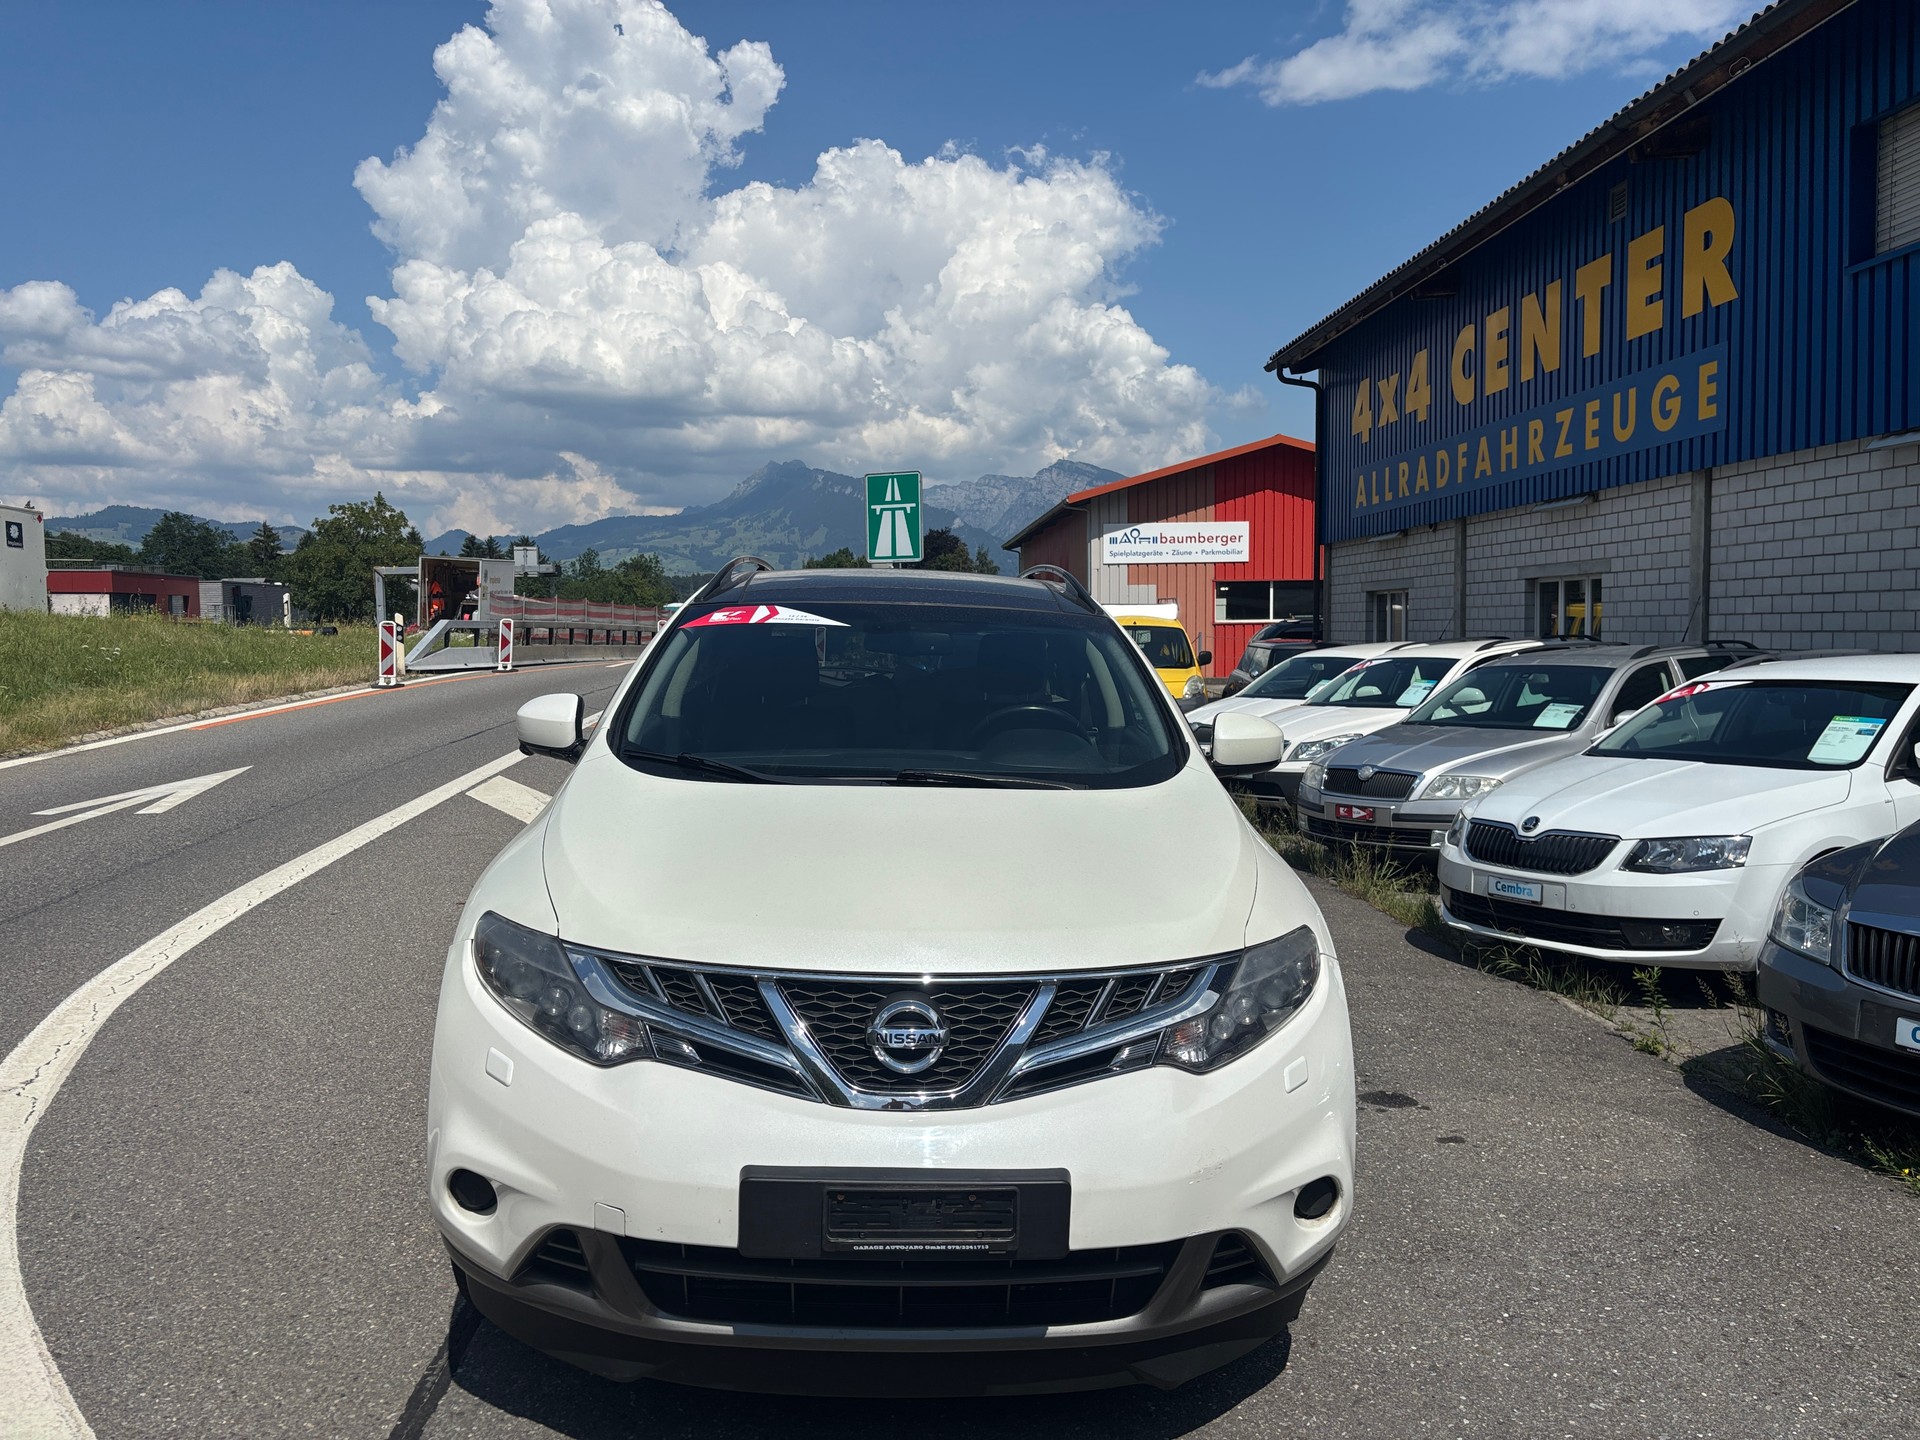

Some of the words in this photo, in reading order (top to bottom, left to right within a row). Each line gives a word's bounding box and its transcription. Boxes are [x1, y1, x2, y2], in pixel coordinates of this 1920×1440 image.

[1352, 348, 1431, 444] 4x4
[1450, 196, 1739, 406] CENTER
[1355, 360, 1718, 509] ALLRADFAHRZEUGE
[1159, 532, 1244, 546] baumberger
[1200, 548, 1244, 556] Parkmobiliar
[1495, 880, 1534, 897] Cembra
[875, 1033, 941, 1044] NISSAN
